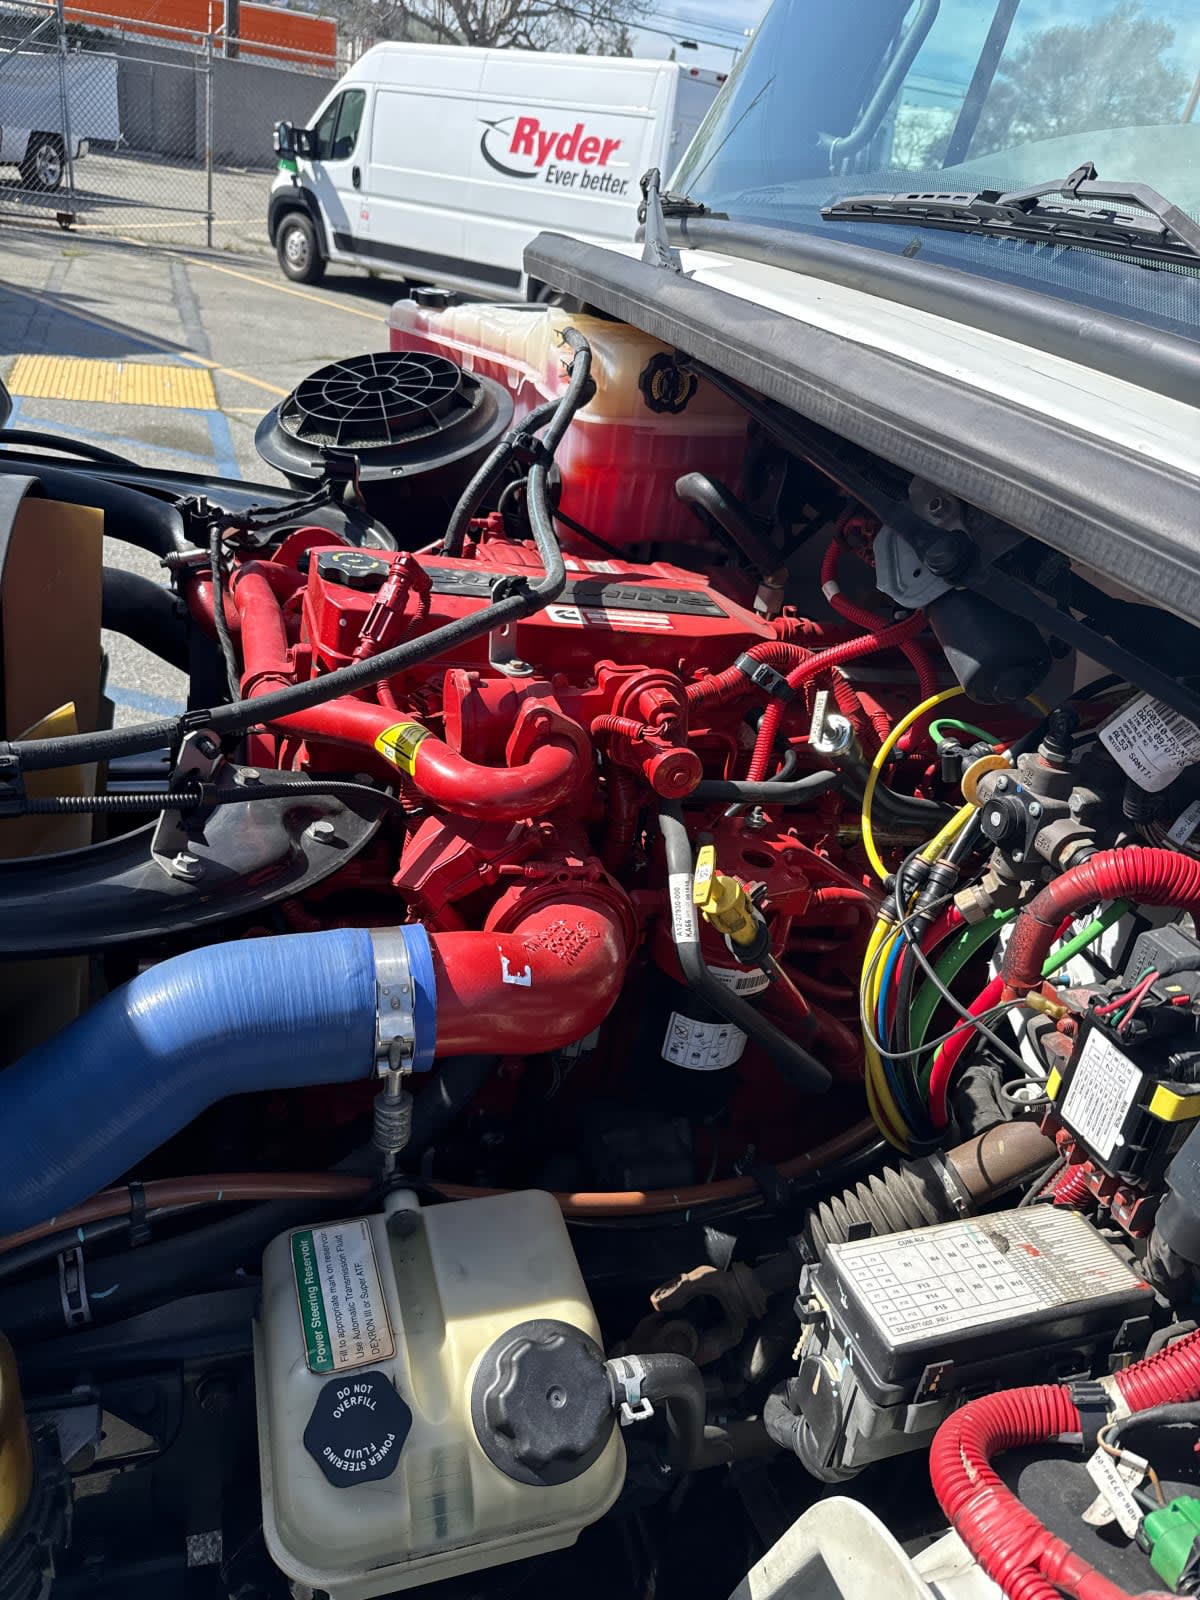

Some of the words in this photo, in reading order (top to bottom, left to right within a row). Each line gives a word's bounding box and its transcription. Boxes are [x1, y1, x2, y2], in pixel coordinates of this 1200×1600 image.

[509, 116, 621, 167] Ryder
[545, 164, 580, 187] Ever
[580, 168, 630, 195] better.
[319, 1232, 332, 1263] reservoir
[302, 1240, 314, 1284] Reservoir
[327, 1264, 335, 1273] on
[327, 1273, 337, 1294] mark
[340, 1254, 353, 1301] Transmission
[360, 1277, 370, 1299] Super
[308, 1285, 321, 1328] Steering
[331, 1295, 345, 1338] appropriate
[363, 1300, 371, 1308] or
[364, 1308, 372, 1319] III
[349, 1301, 361, 1340] Automatic
[315, 1331, 327, 1363] Power
[338, 1338, 346, 1346] to
[365, 1318, 380, 1355] DEXRON
[339, 1345, 349, 1362] Fill
[356, 1343, 365, 1358] Use
[336, 1387, 351, 1400] DO
[353, 1384, 373, 1394] NOT
[333, 1395, 377, 1418] OVERFILL
[323, 1446, 367, 1472] STEERING
[344, 1442, 377, 1459] FLUID
[368, 1433, 396, 1466] POWER
